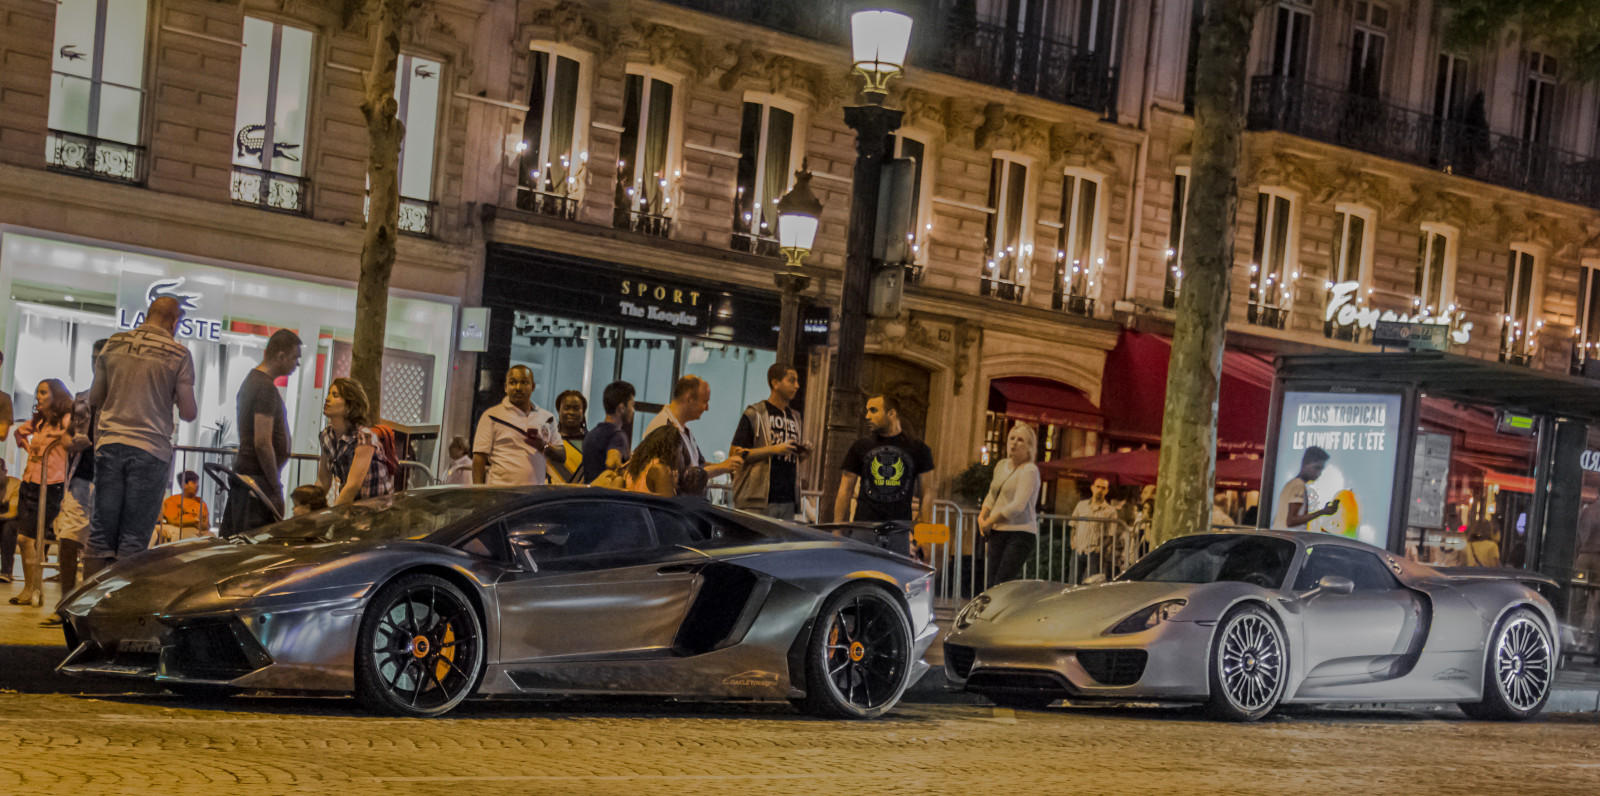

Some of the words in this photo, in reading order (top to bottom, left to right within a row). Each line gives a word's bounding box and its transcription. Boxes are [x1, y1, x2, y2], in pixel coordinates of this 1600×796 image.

[621, 280, 700, 306] SPORT
[619, 301, 645, 318] The
[120, 309, 221, 340] LASTE
[1300, 405, 1330, 424] OASIS
[1333, 405, 1383, 424] TROPICAL
[1293, 431, 1305, 450] LE
[1342, 432, 1356, 450] DE
[1358, 429, 1386, 451] L'ÉTÉ
